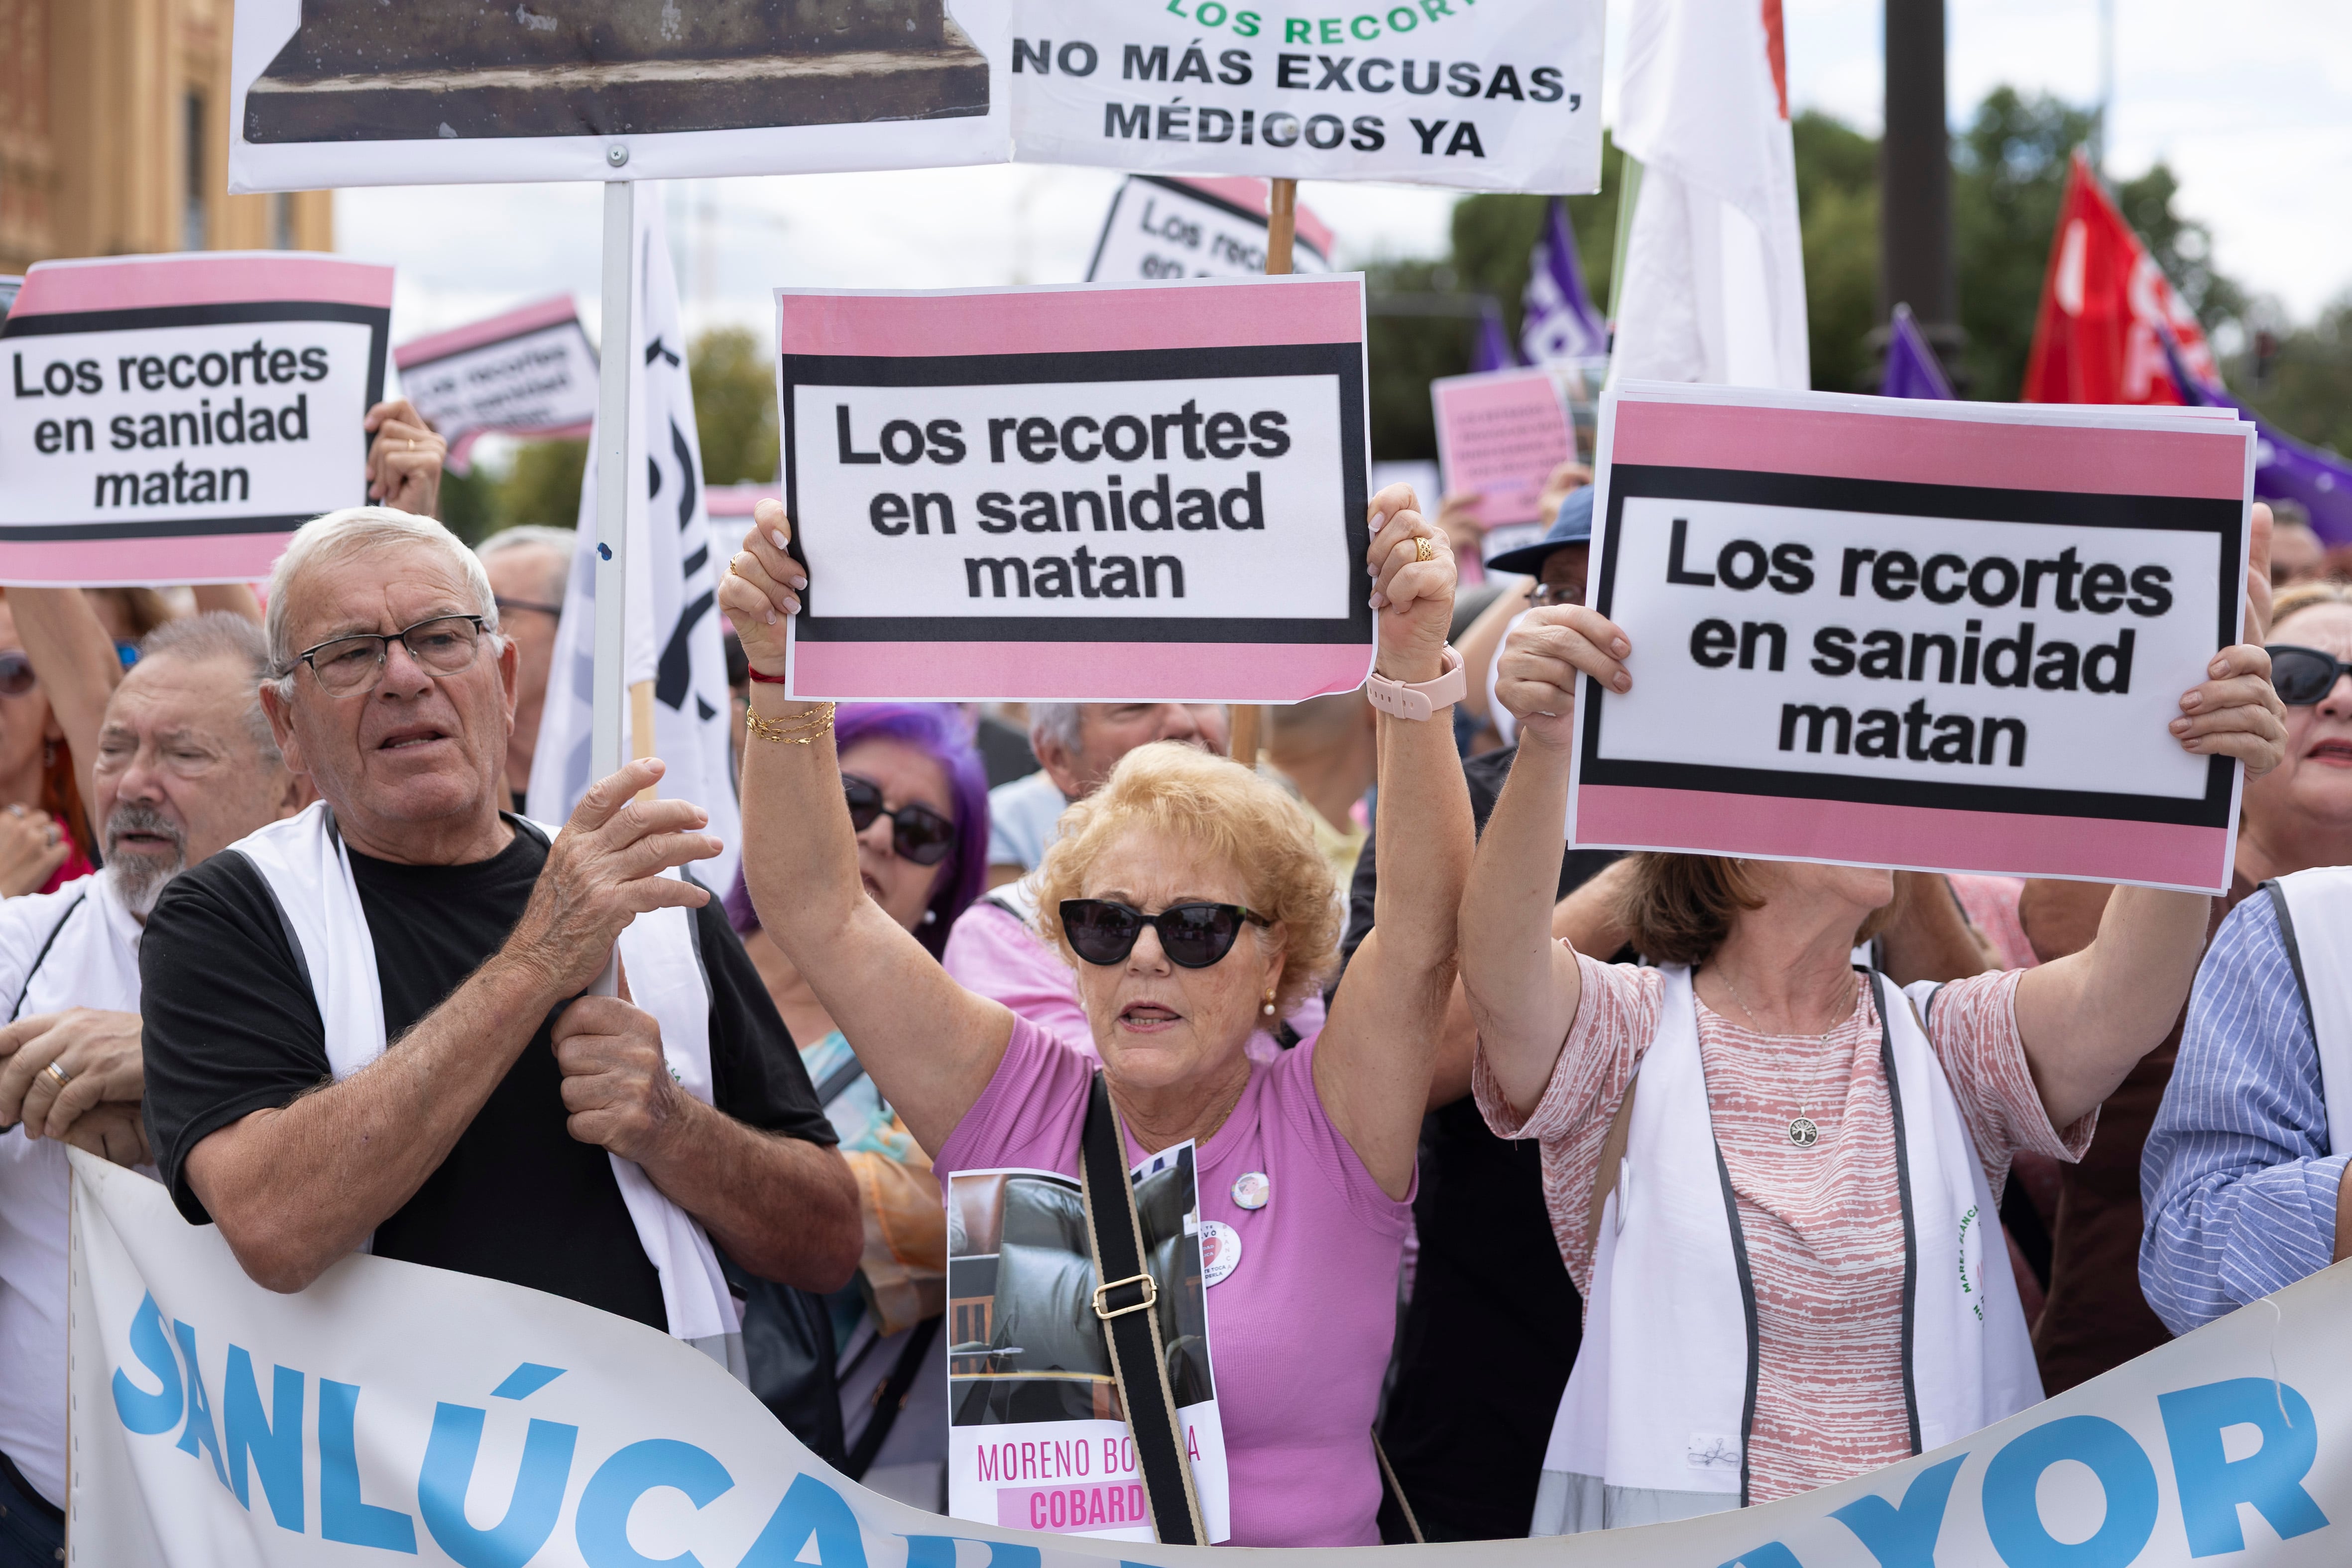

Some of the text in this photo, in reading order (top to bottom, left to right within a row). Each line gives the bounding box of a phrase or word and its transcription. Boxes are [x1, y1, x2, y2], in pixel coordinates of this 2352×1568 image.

[1166, 0, 1476, 45] LOS RECOR
[1012, 38, 1581, 112] NO MÁS EXCUSAS,
[1104, 98, 1486, 158] MÉDICOS YA
[1140, 197, 1201, 249] Los
[13, 340, 329, 398] Los recortes
[34, 393, 309, 454] en sanidad
[836, 399, 1291, 466] Los recortes
[95, 461, 249, 508] matan
[869, 471, 1265, 536] en sanidad
[964, 545, 1185, 599] matan
[1666, 519, 2174, 618] Los recortes
[1689, 618, 2136, 695] en sanidad
[1777, 698, 2028, 768] matan
[1201, 1230, 1216, 1239] VÓ
[1959, 1249, 1972, 1293] MAREA
[977, 1439, 1090, 1482] MORENO
[1030, 1484, 1145, 1530] COBARD
